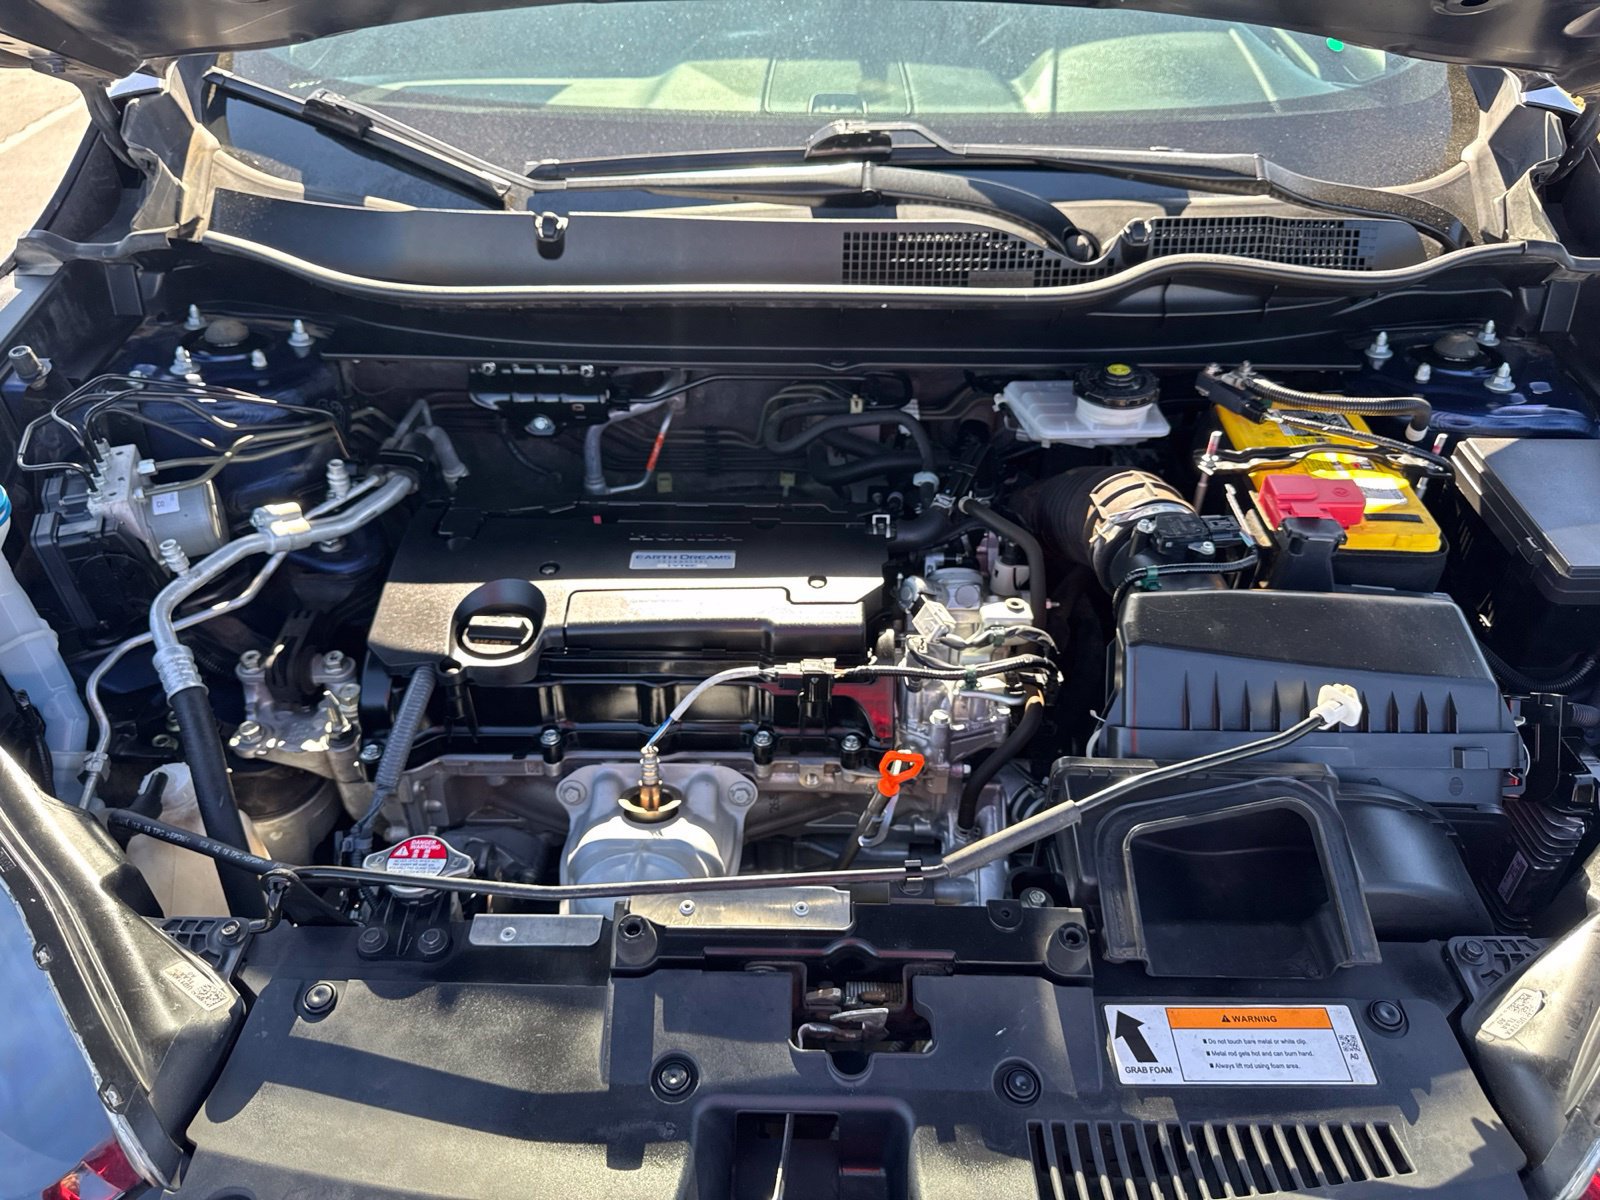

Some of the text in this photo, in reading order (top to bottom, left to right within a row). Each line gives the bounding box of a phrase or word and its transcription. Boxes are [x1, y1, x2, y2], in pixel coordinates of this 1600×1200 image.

[1231, 1015, 1278, 1023] WARNING
[1125, 1066, 1173, 1074] GRAB FOAM
